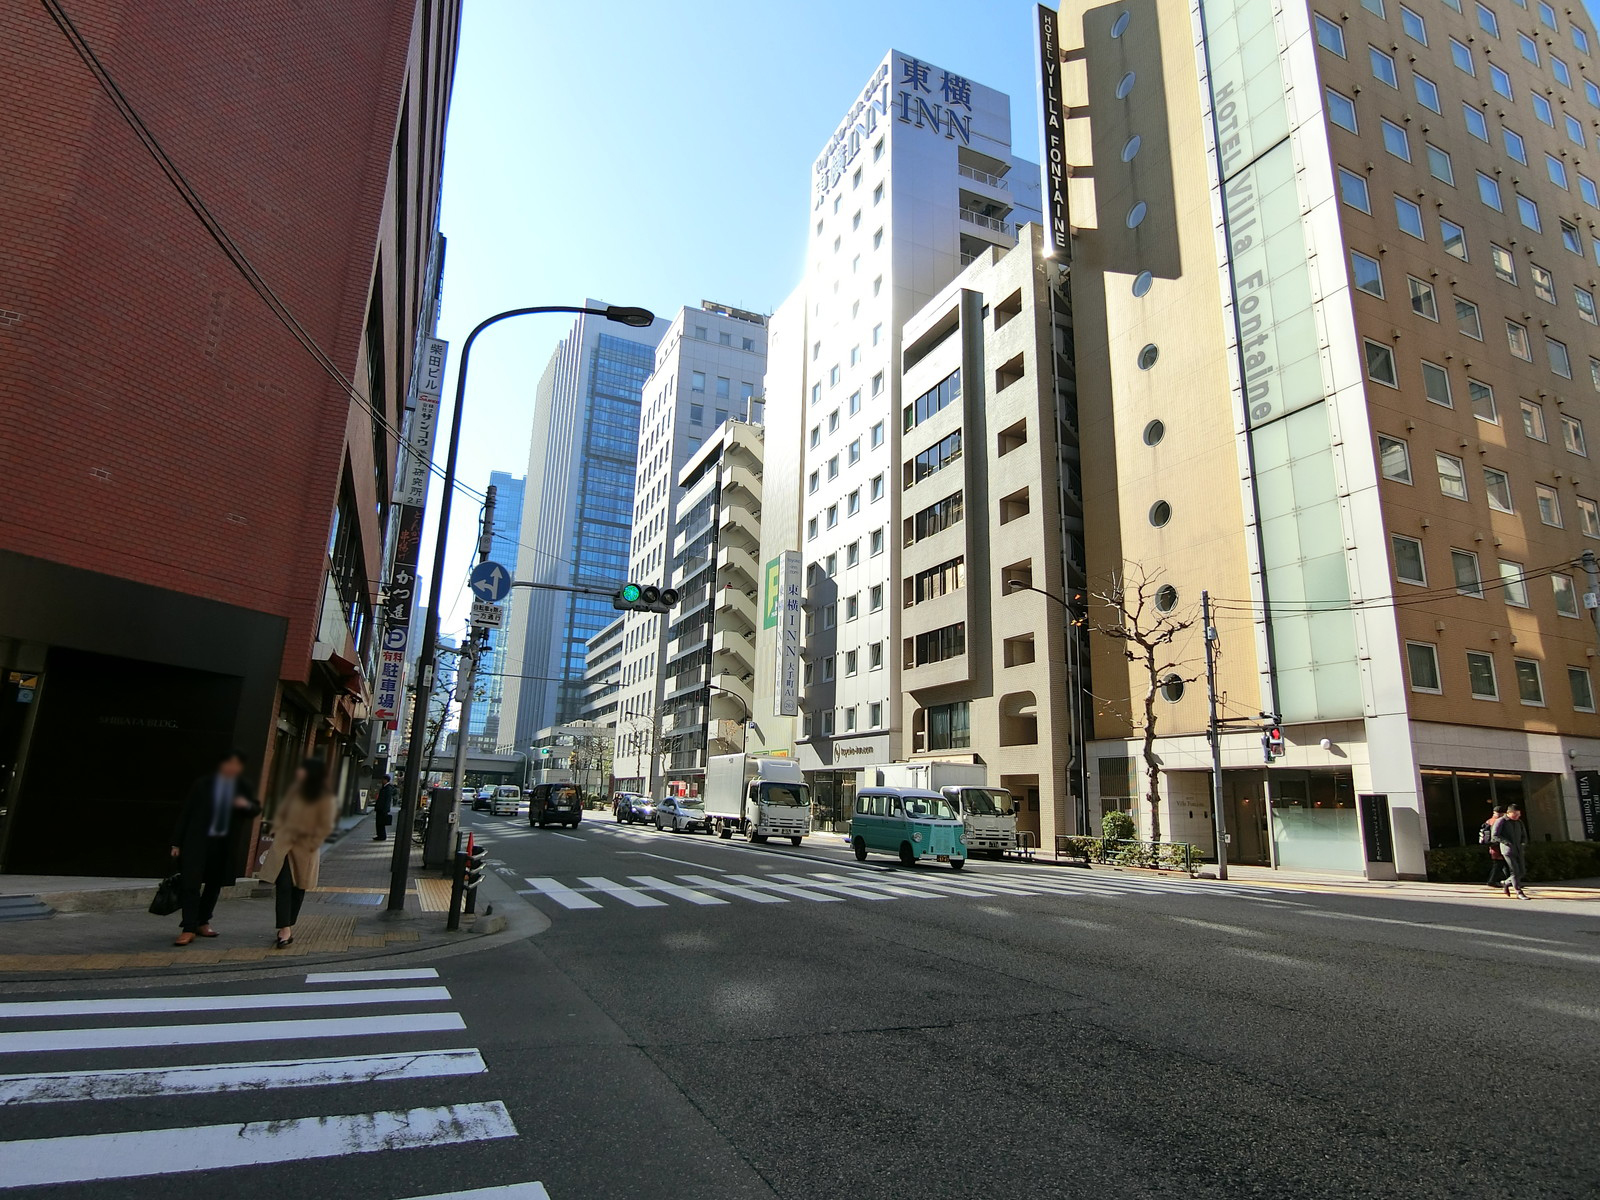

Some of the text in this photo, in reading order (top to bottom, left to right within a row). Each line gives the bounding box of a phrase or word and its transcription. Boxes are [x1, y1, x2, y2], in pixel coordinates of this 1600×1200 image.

[899, 57, 972, 112] 東横
[898, 90, 972, 145] INN
[1044, 15, 1066, 248] HOTEL VILLA FONTAINE
[1215, 80, 1274, 421] HOTEL Villa Fontaine
[425, 343, 443, 390] 柴田ビル
[387, 631, 403, 645] P
[786, 584, 799, 657] 東横INN
[382, 650, 403, 663] 有料
[377, 662, 400, 709] 駐車場
[378, 744, 387, 753] P
